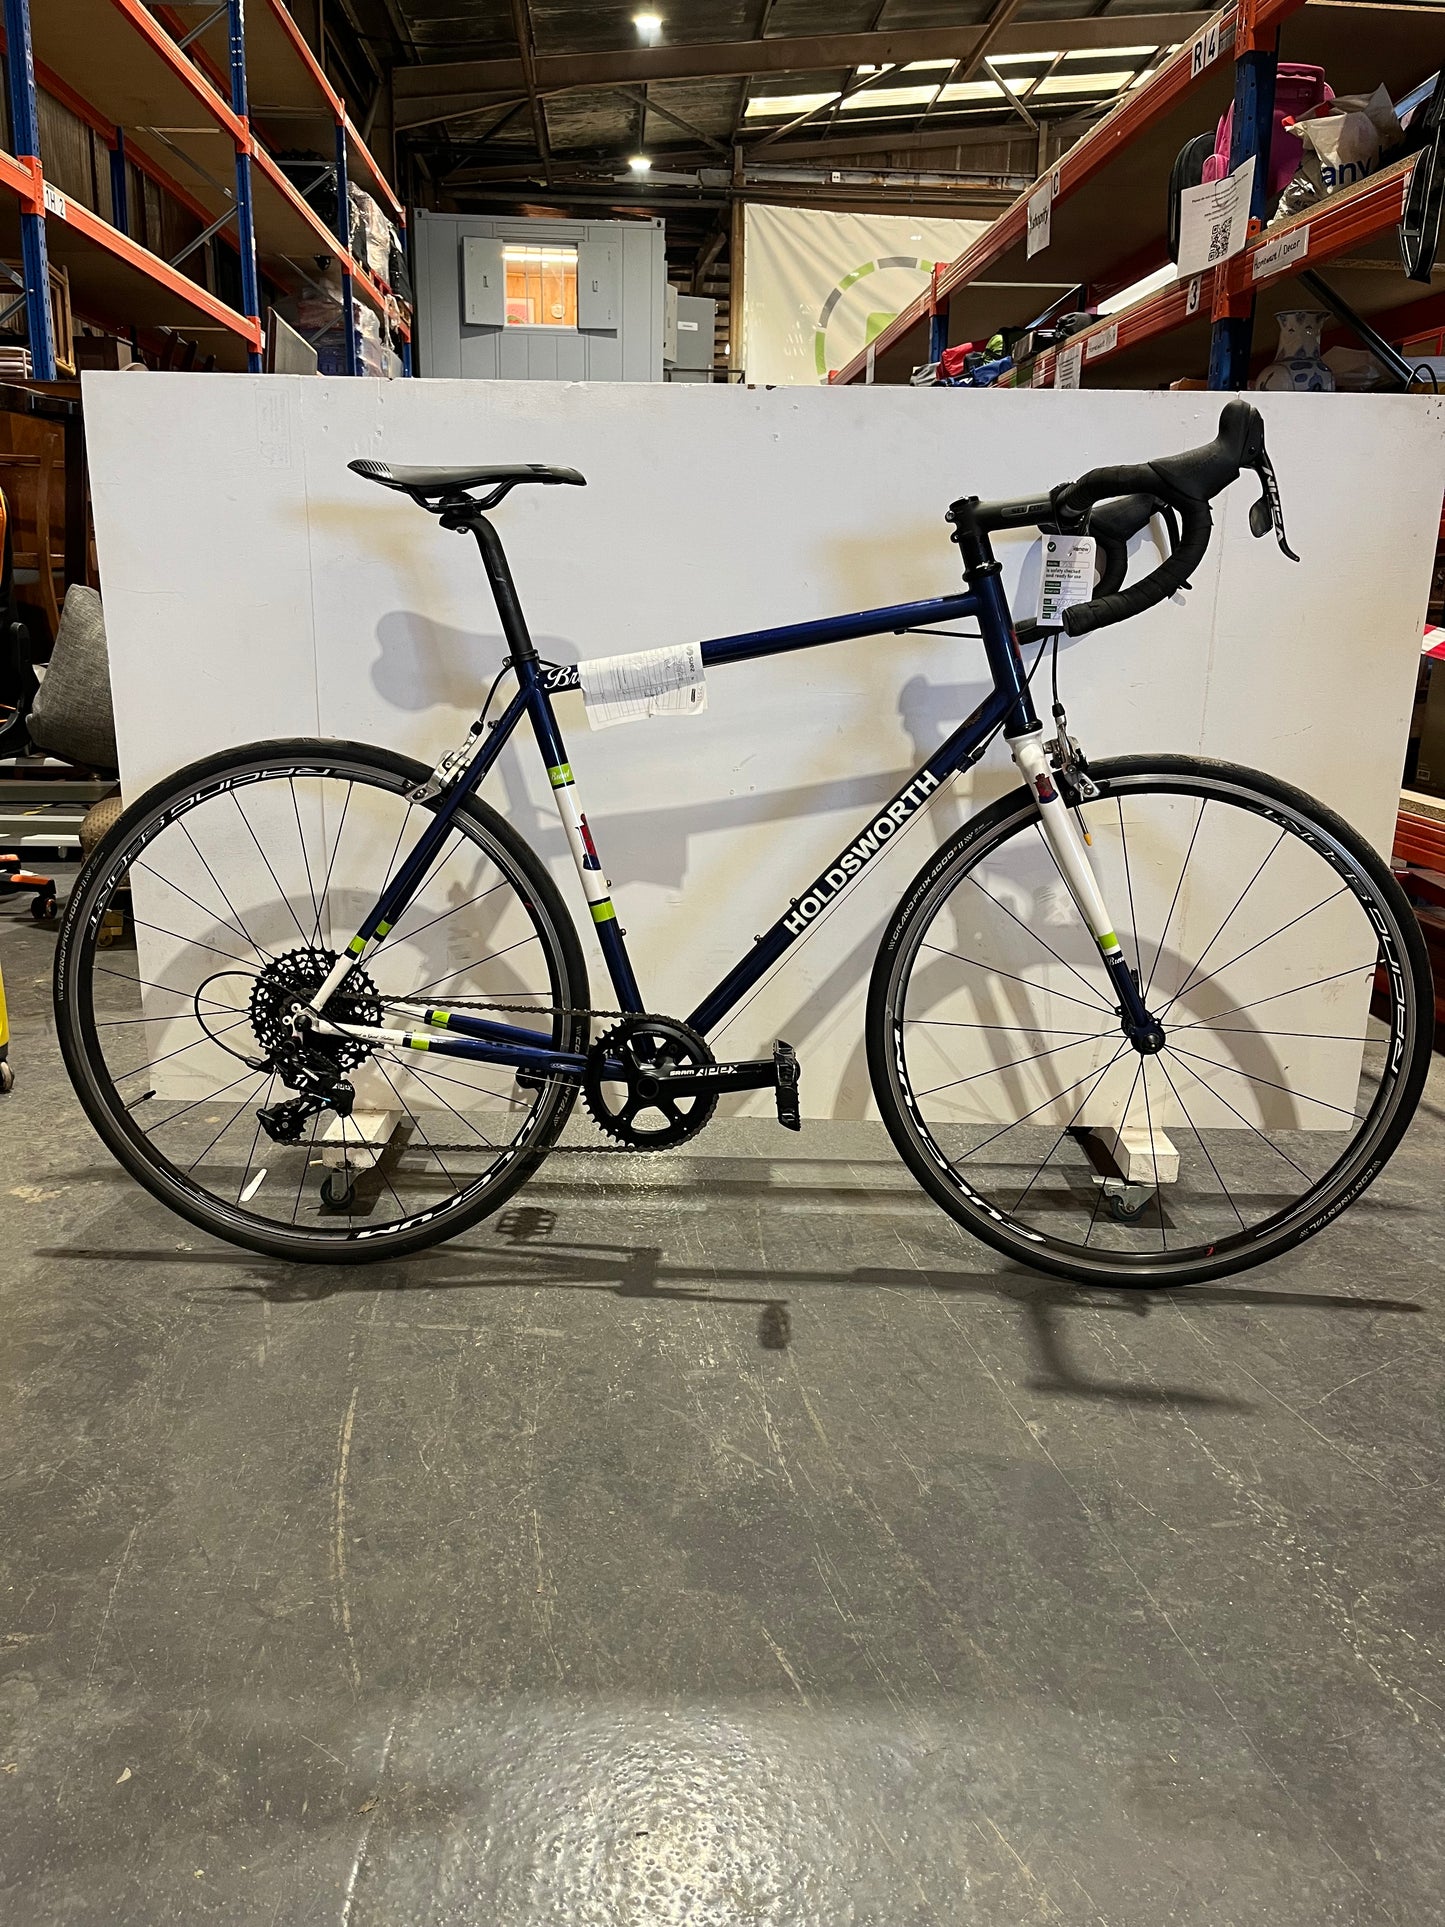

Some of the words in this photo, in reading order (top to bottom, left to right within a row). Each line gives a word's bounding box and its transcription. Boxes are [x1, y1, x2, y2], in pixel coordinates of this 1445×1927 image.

[1189, 279, 1199, 311] 3
[783, 769, 940, 935] HOLDSWORTH
[892, 901, 915, 941] GRAND
[912, 876, 932, 904] PRIX
[669, 1069, 695, 1077] SRAM
[1308, 1168, 1374, 1229] CONTINENTAL
